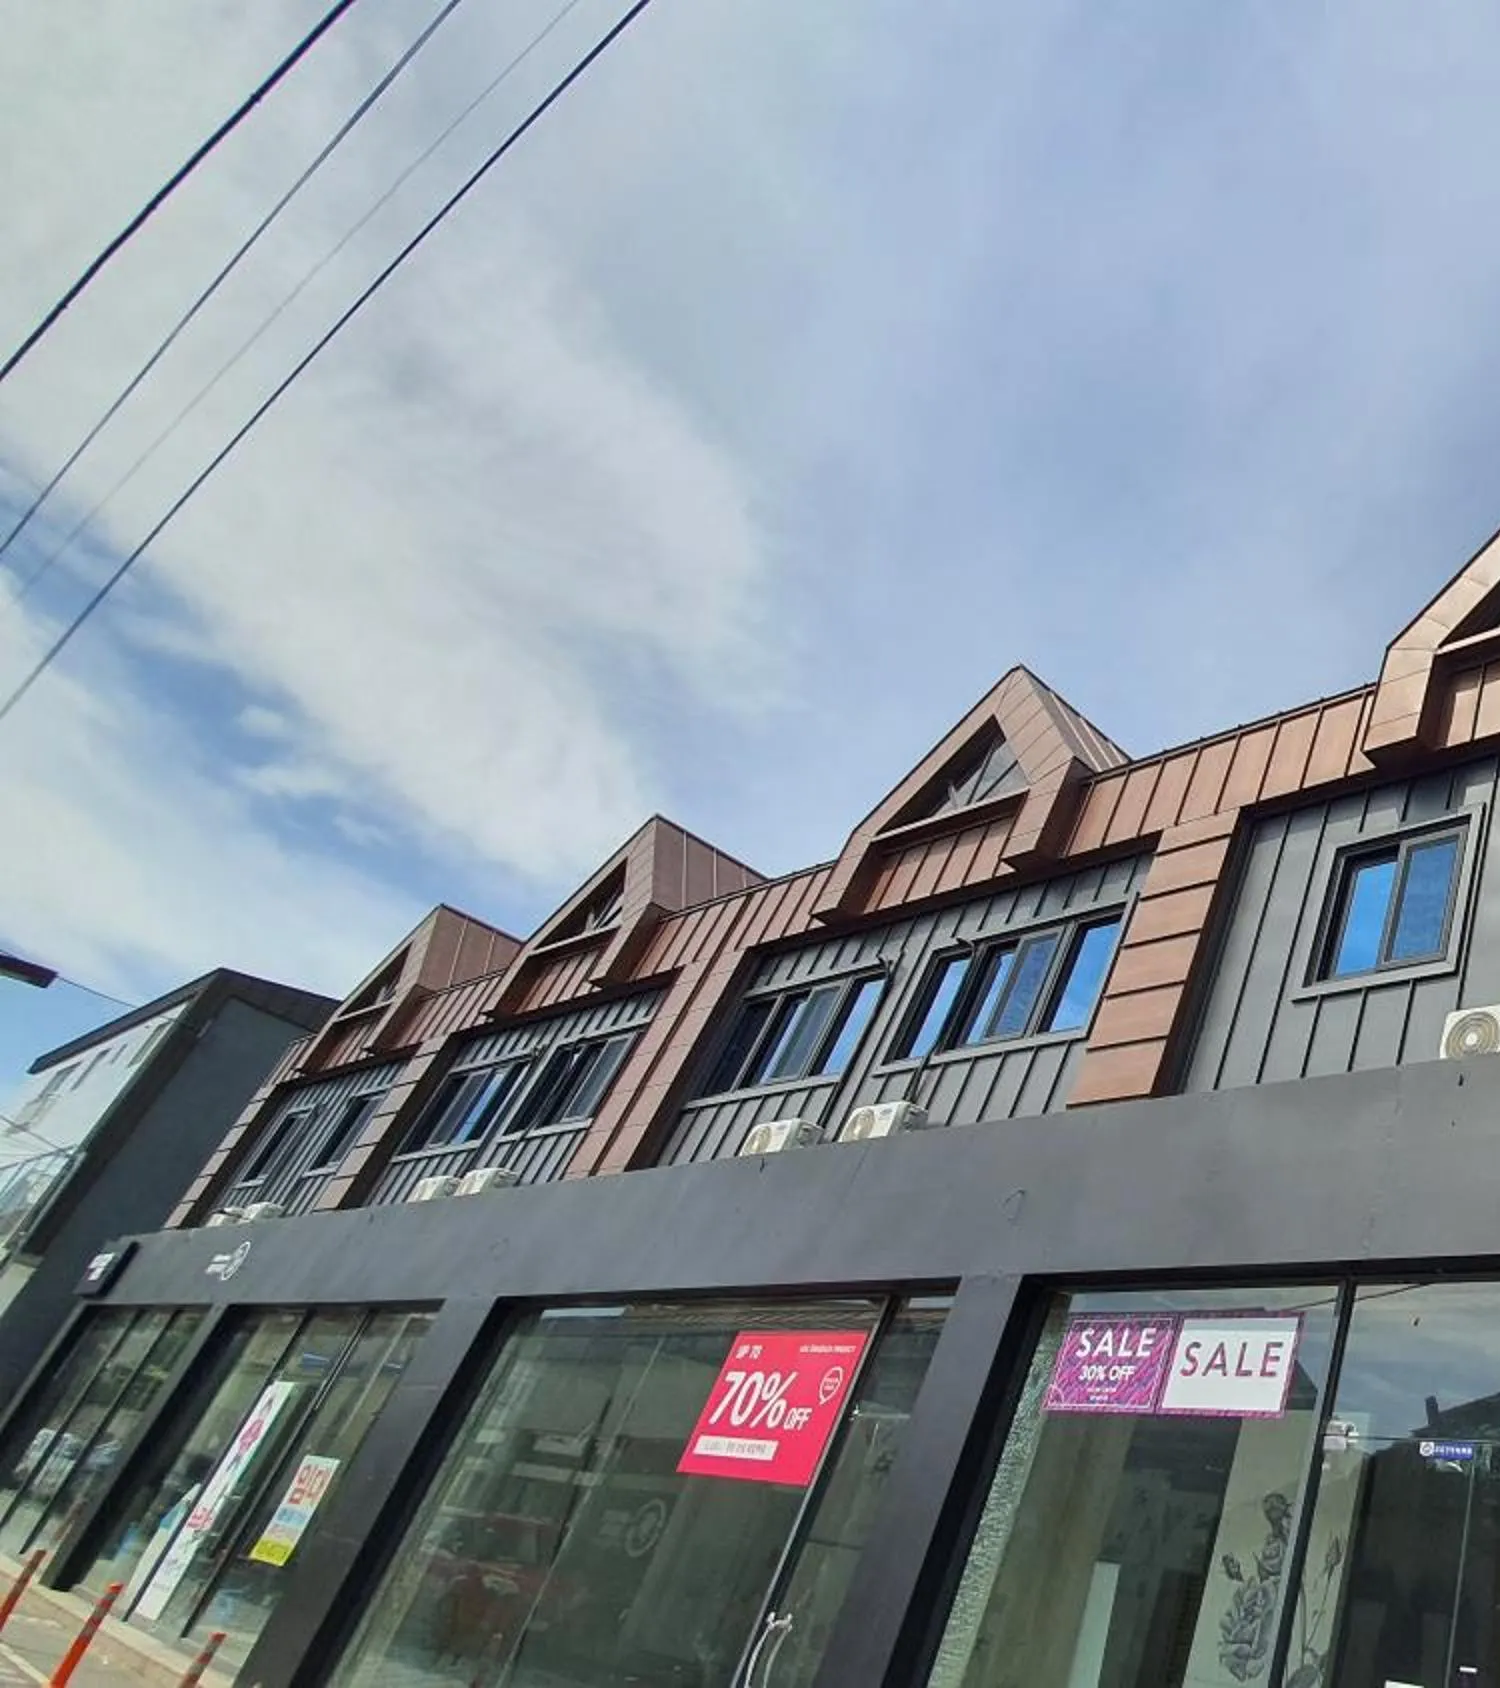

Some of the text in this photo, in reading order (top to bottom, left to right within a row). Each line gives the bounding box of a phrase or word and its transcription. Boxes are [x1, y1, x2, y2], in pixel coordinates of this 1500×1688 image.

[1075, 1327, 1157, 1358] SALE
[1180, 1341, 1284, 1377] SALE
[1078, 1364, 1136, 1382] 30% OFF
[709, 1371, 812, 1430] 70% OFF
